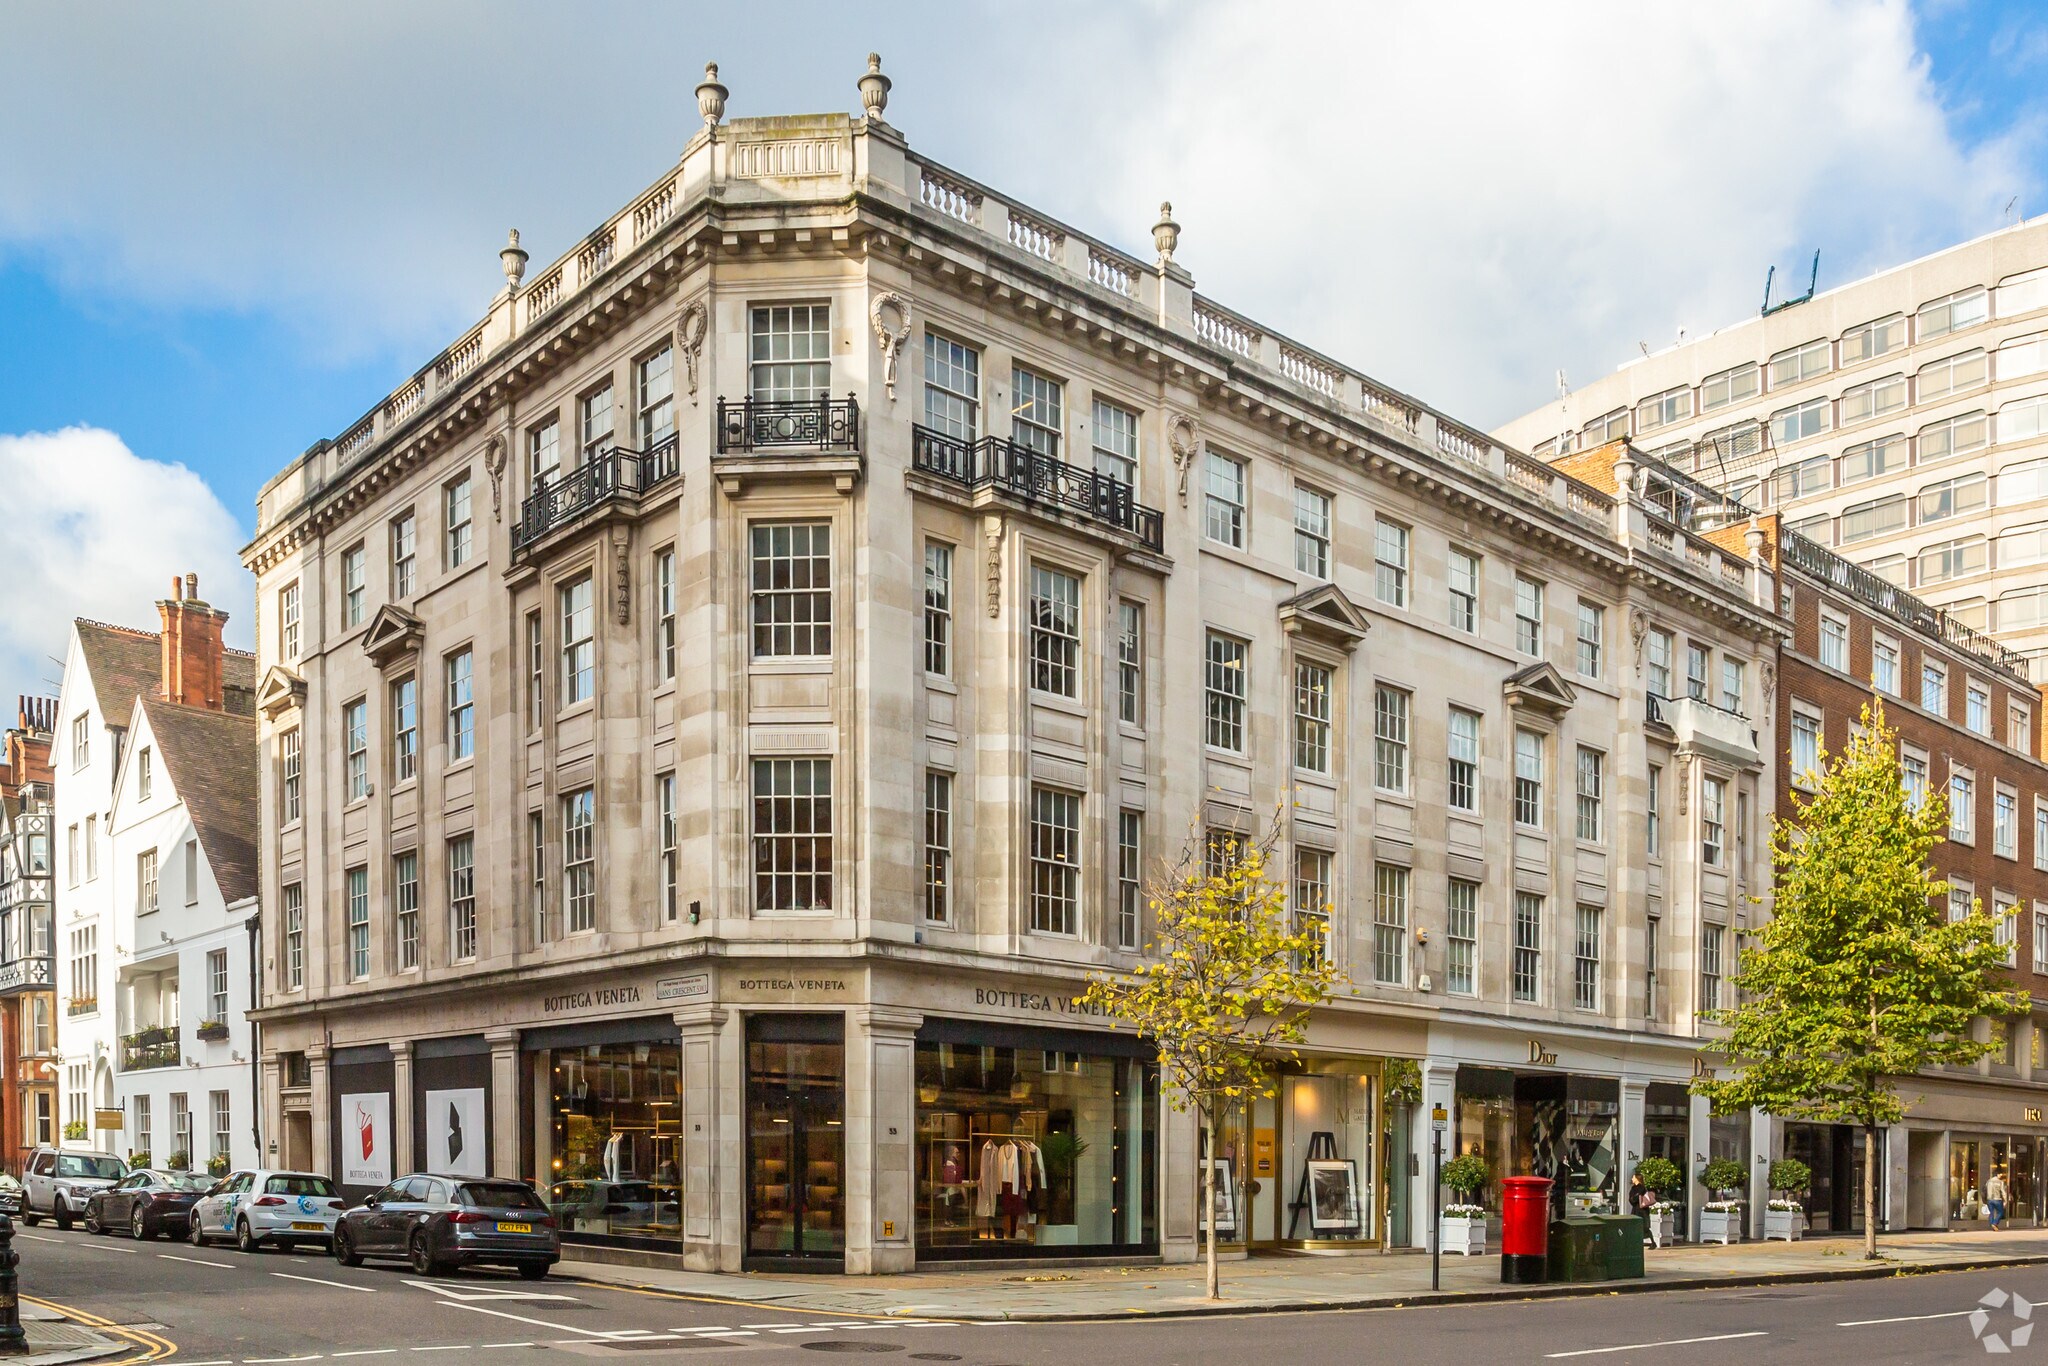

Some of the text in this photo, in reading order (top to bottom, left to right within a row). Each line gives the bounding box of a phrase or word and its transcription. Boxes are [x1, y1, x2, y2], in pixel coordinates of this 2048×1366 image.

[672, 985, 697, 996] CRESCENT
[740, 980, 845, 990] BOTTEGA VENETA
[544, 986, 640, 1012] BOTTEGA VENETA
[975, 988, 1052, 1011] BOTTEGA
[1528, 1040, 1558, 1065] Dior
[1692, 1057, 1716, 1079] Dior
[1402, 1074, 1413, 1087] 32
[1628, 1150, 1640, 1161] Dior
[1696, 1152, 1707, 1163] Dior
[1757, 1154, 1767, 1164] Dior
[349, 1170, 384, 1179] BOTTEGA VENETA
